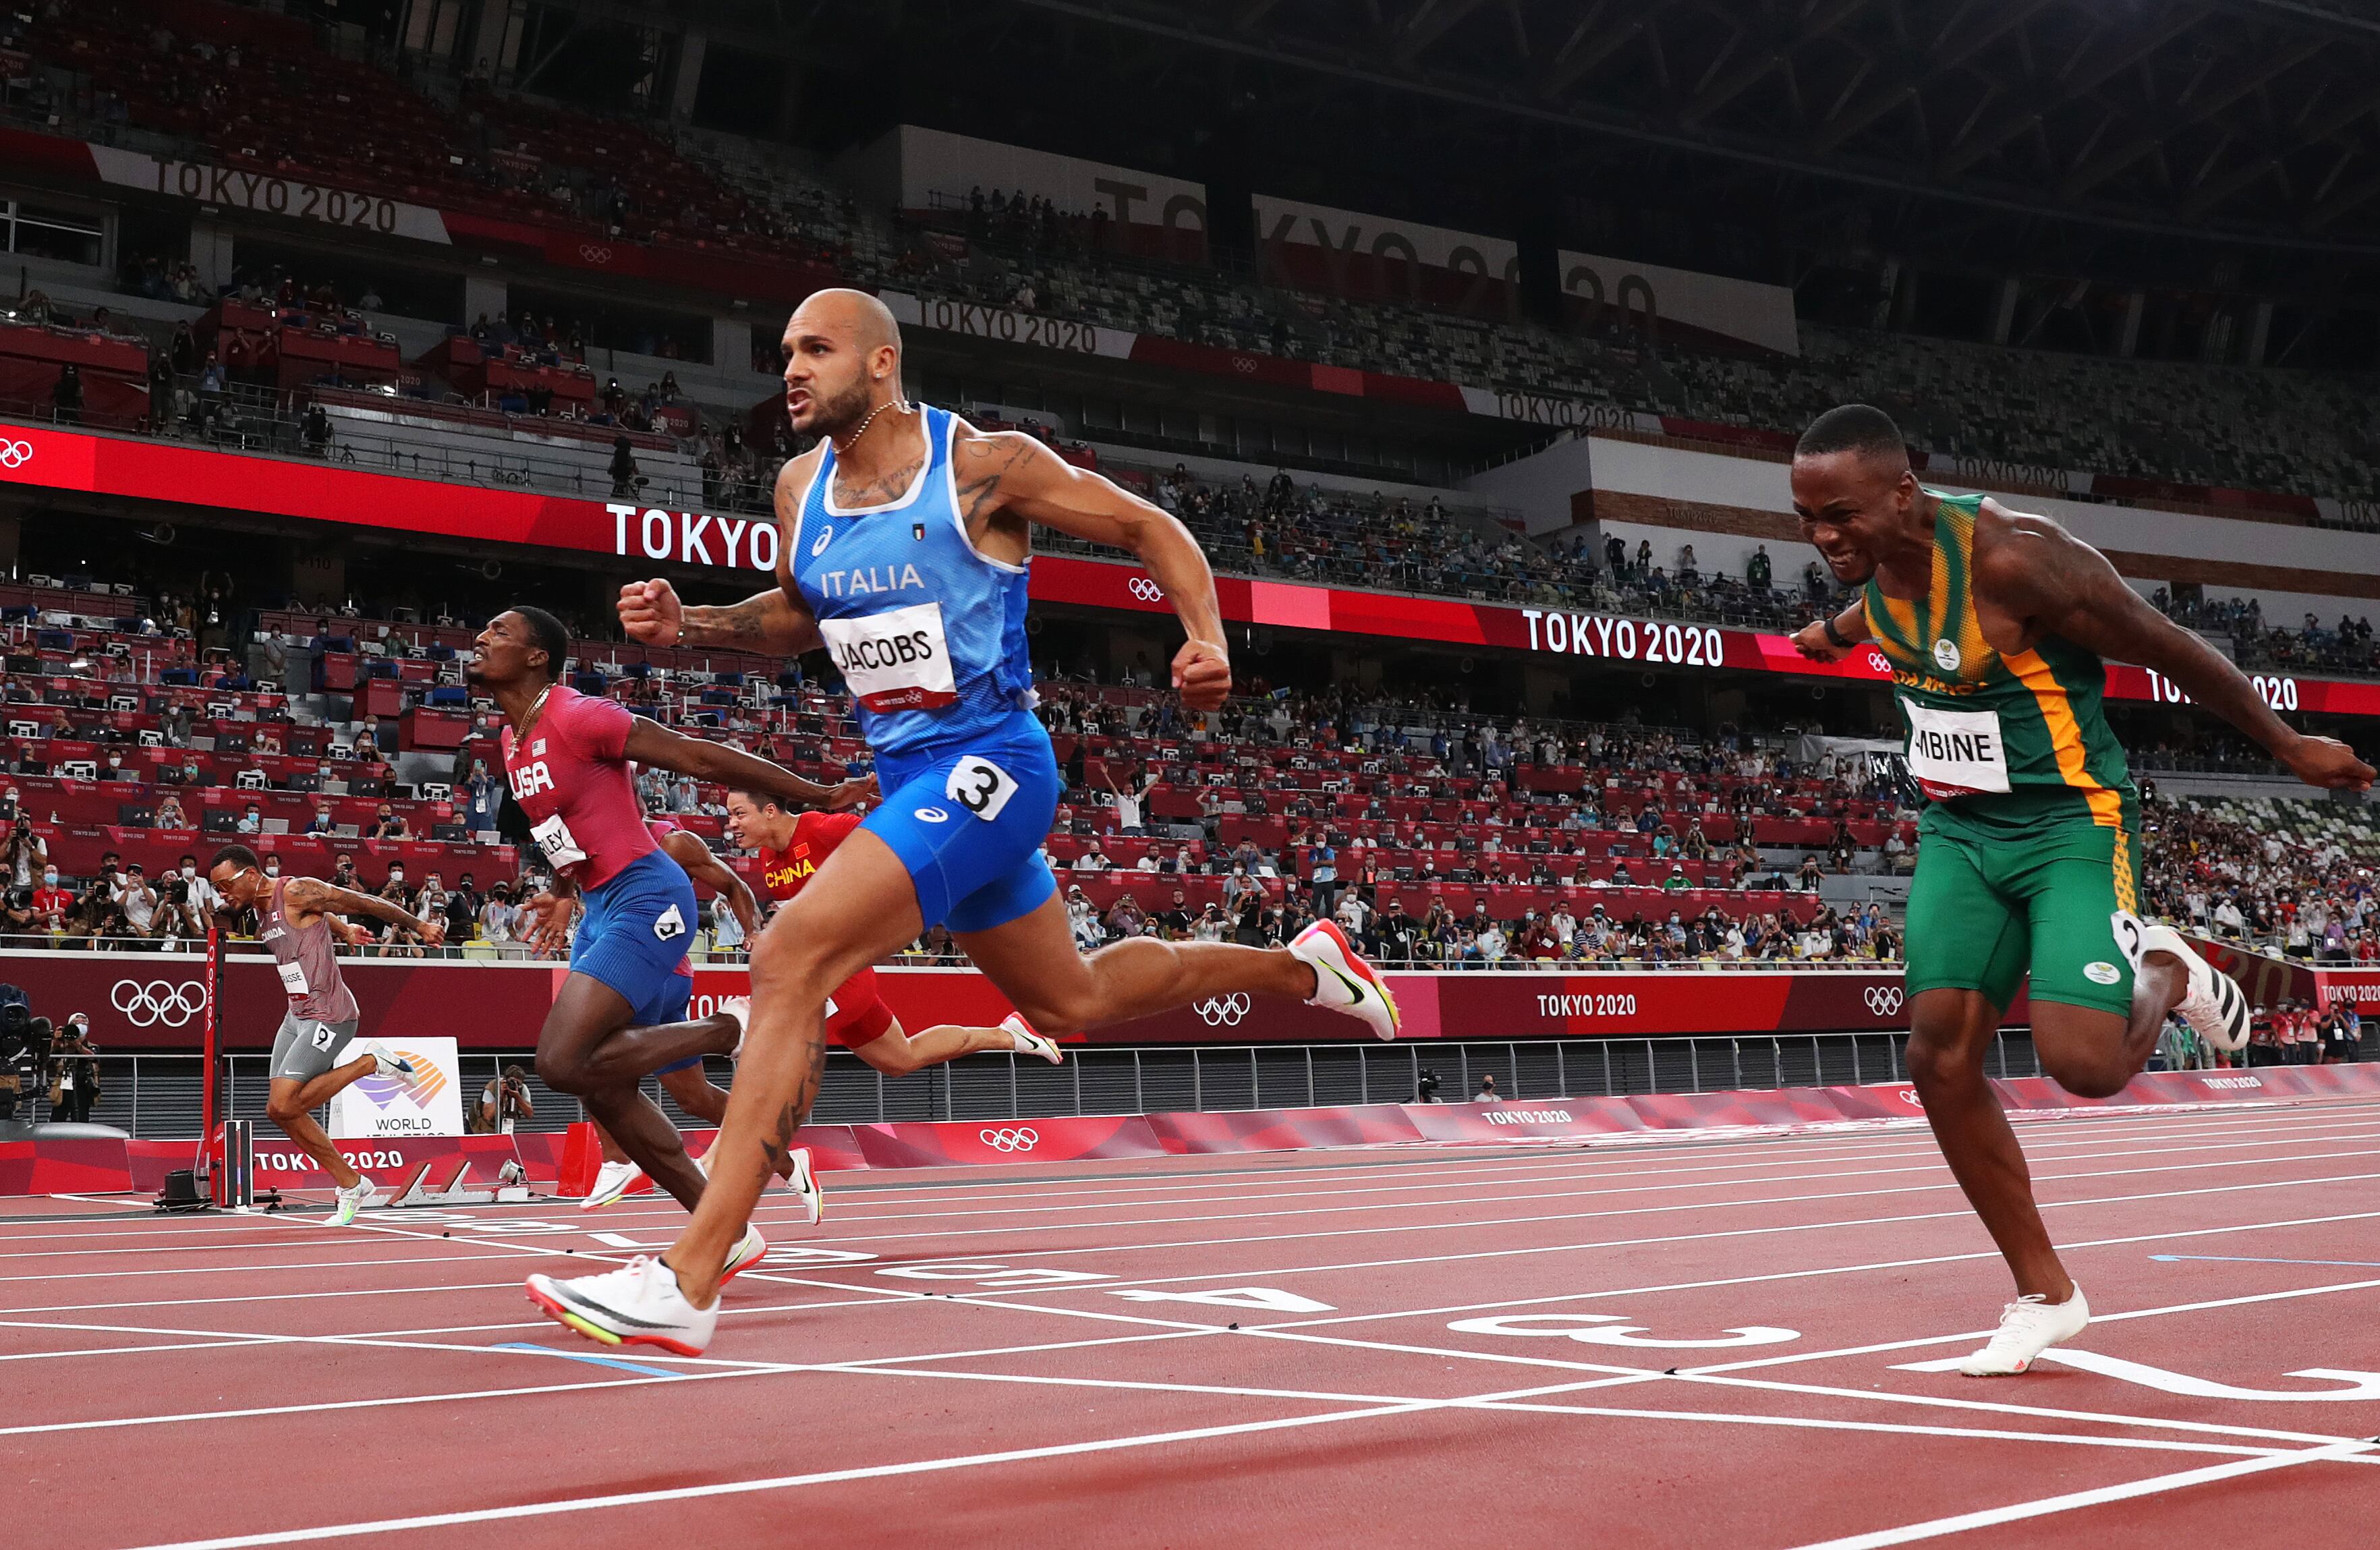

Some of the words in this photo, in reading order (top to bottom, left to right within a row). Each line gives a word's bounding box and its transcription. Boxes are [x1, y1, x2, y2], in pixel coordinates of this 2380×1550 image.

[152, 156, 288, 214] TOKYO
[301, 185, 396, 234] 2020
[915, 297, 1015, 341] TOKYO
[1025, 315, 1096, 353] 2020
[401, 374, 420, 386] 2020
[670, 417, 689, 428] 2020
[1494, 389, 1572, 426] TOKYO
[1579, 403, 1635, 431] 2020
[1952, 457, 2017, 483] TOKYO
[2022, 465, 2068, 489] 2020
[606, 503, 778, 571] TOKYO
[820, 563, 925, 598] ITALIA
[838, 630, 932, 670] JACOBS
[1522, 609, 1637, 660] TOKYO
[1644, 622, 1724, 668] 2020
[2252, 676, 2298, 712] 020
[509, 761, 555, 799] USA
[957, 766, 998, 812] 3
[765, 858, 817, 889] CHINA
[261, 926, 287, 943] CANADA
[1537, 994, 1593, 1016] TOKYO
[1596, 994, 1637, 1016] 2020
[2321, 985, 2357, 1002] TOKYO
[2358, 985, 2380, 1002] 202
[316, 1028, 329, 1045] 9
[2202, 1077, 2238, 1089] TOKYO
[2233, 1076, 2263, 1089] 2020
[375, 1118, 431, 1130] WORLD
[1481, 1111, 1535, 1126] TOKYO
[1533, 1110, 1572, 1123] 2020
[255, 1152, 320, 1171] TOKY
[341, 1151, 403, 1170] 2020
[1104, 1286, 1339, 1313] 4
[1446, 1313, 1802, 1348] 3
